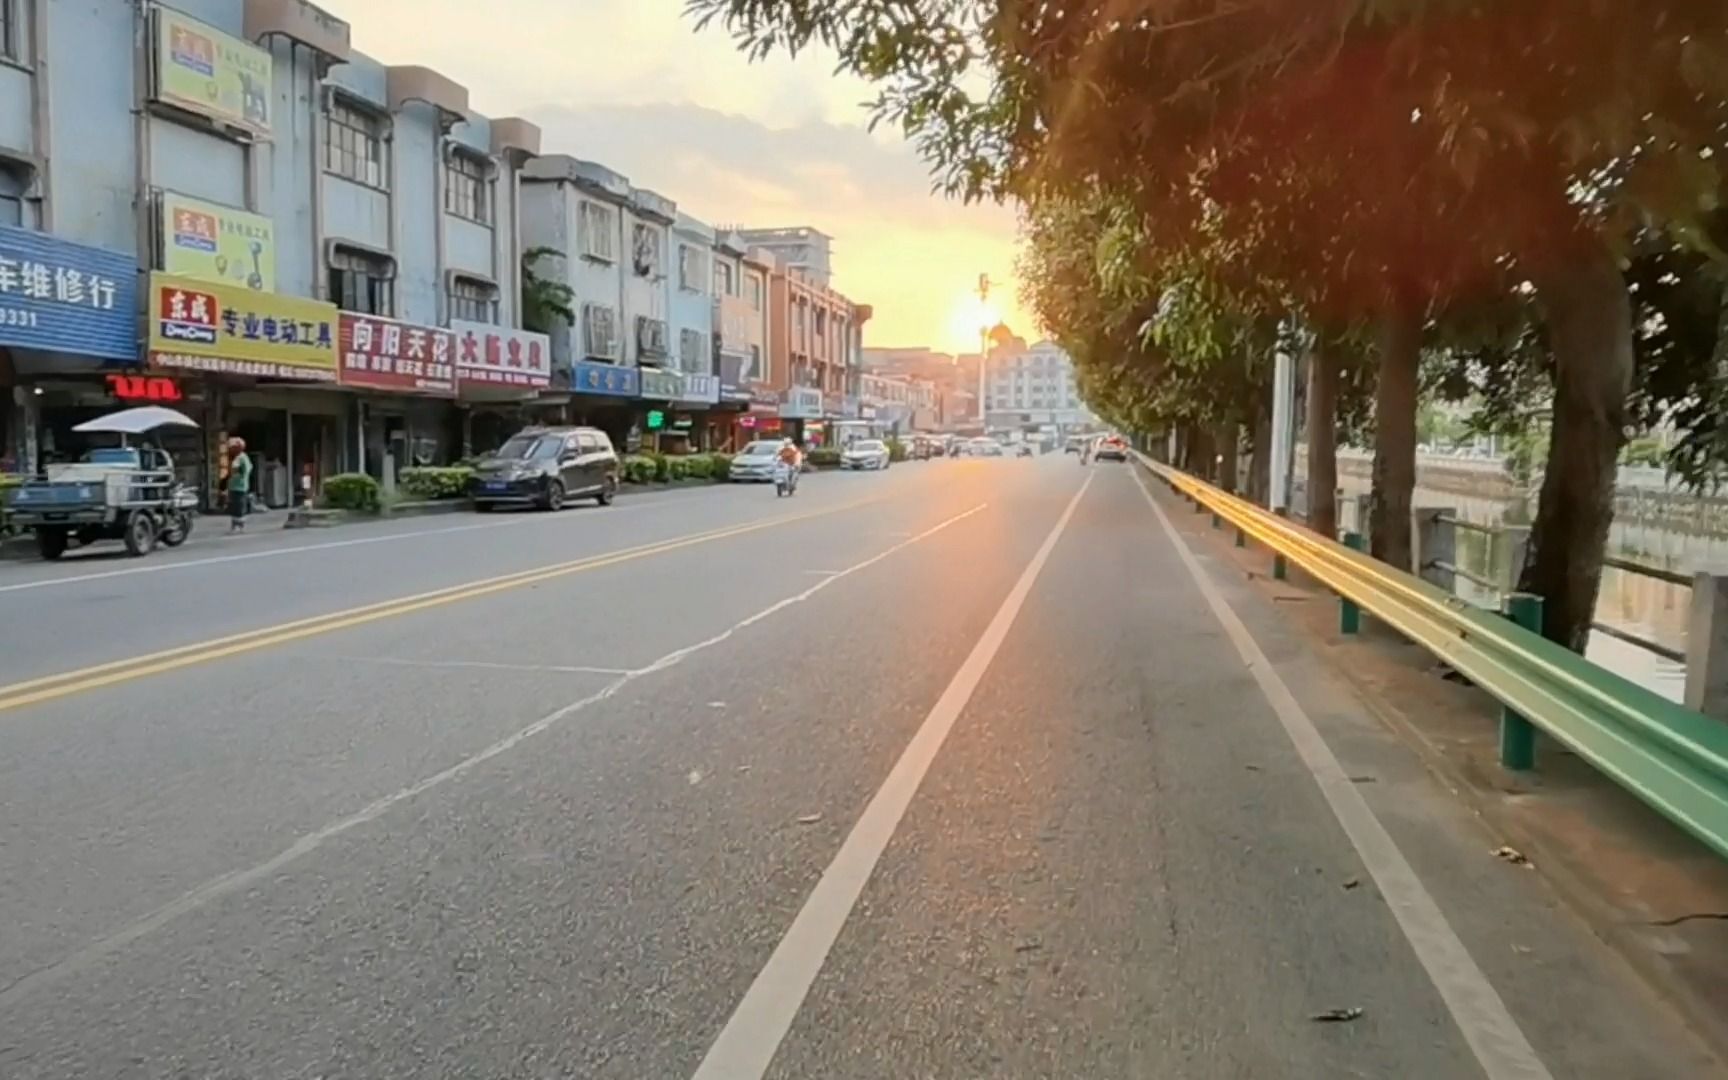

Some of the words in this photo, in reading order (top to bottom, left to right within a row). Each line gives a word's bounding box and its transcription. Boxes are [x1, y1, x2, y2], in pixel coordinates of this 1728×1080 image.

[169, 290, 209, 325] 东成
[221, 307, 333, 350] 专业电动工具
[353, 319, 449, 363] 向阳天花
